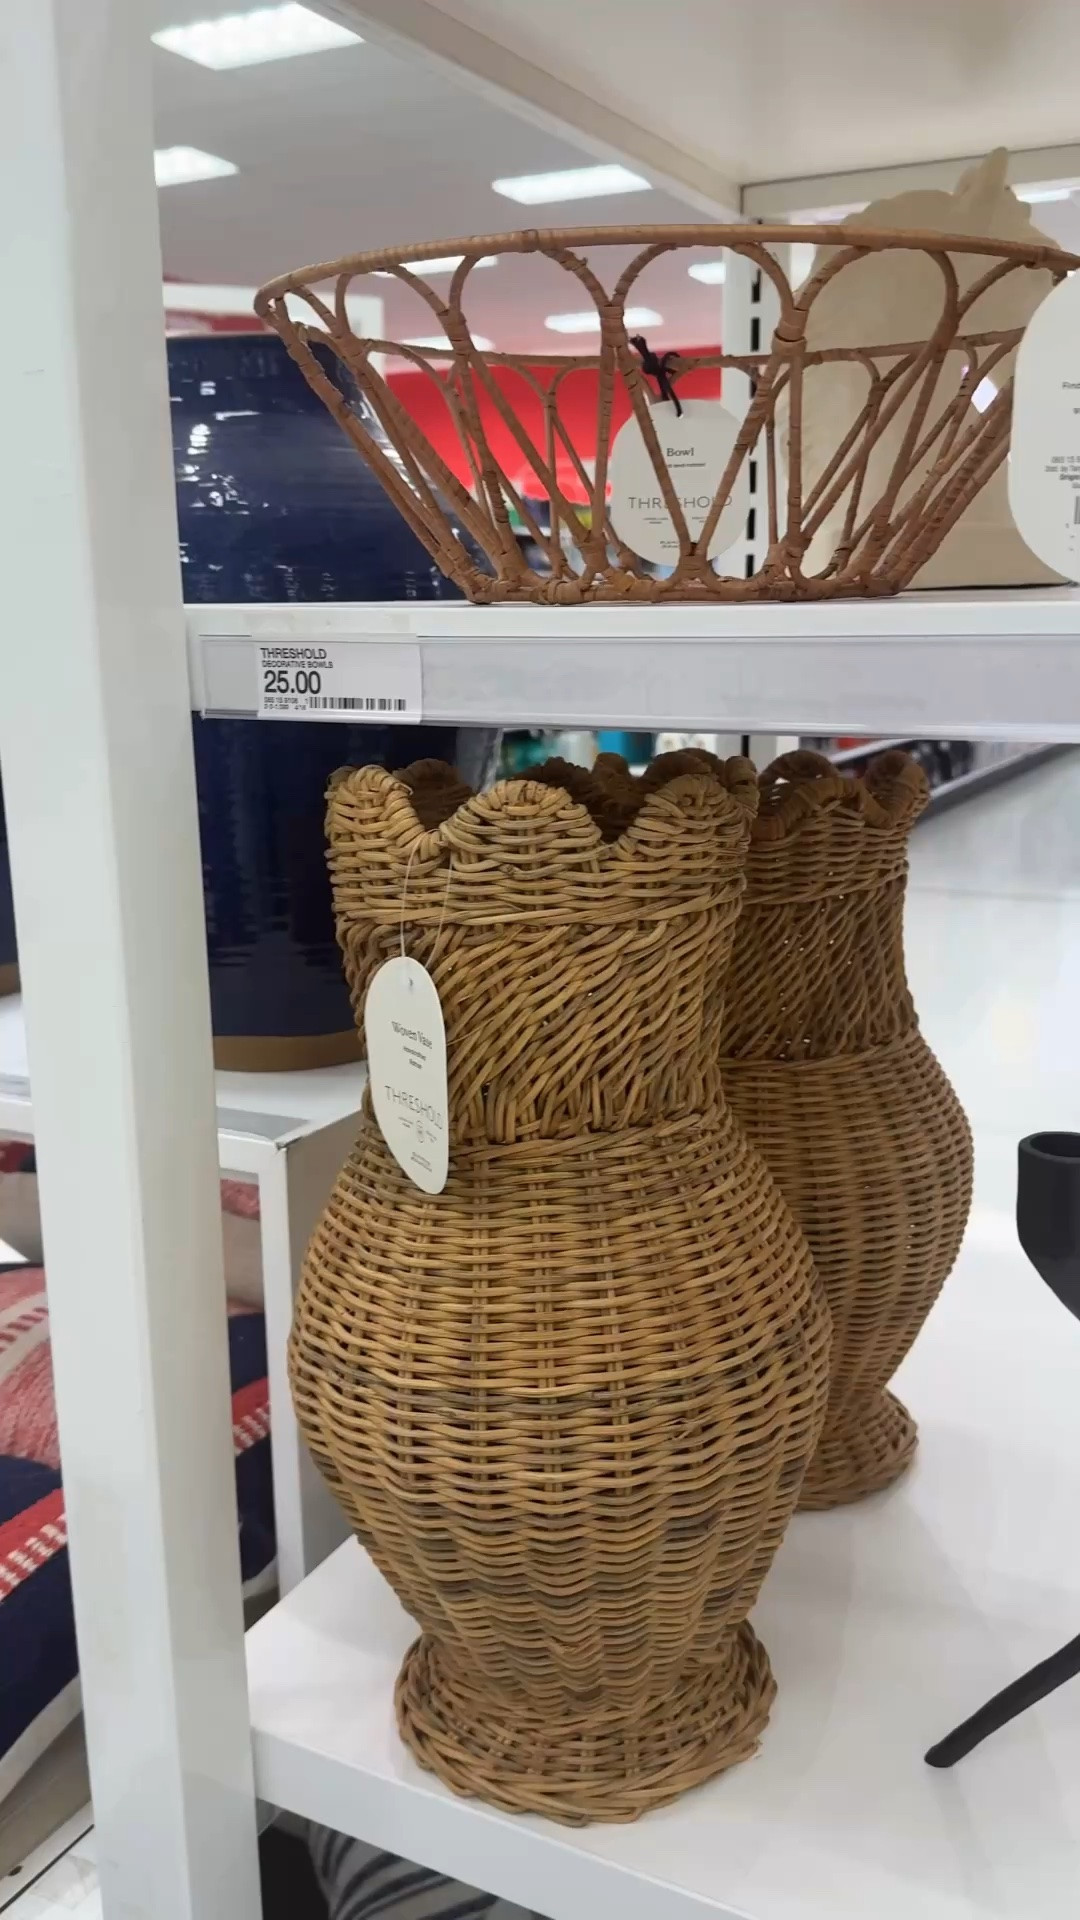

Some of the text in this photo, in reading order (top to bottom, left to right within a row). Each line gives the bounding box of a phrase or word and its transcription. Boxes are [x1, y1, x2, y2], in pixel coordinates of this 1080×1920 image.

[666, 447, 695, 457] Bowl
[628, 495, 733, 509] THRHOD
[260, 647, 327, 659] THRESHOLD
[262, 660, 334, 669] DECORATIVE BOWLS
[264, 669, 322, 695] 25.00
[391, 1020, 433, 1049] Woven Vase
[384, 1085, 443, 1130] THRESHOLD
